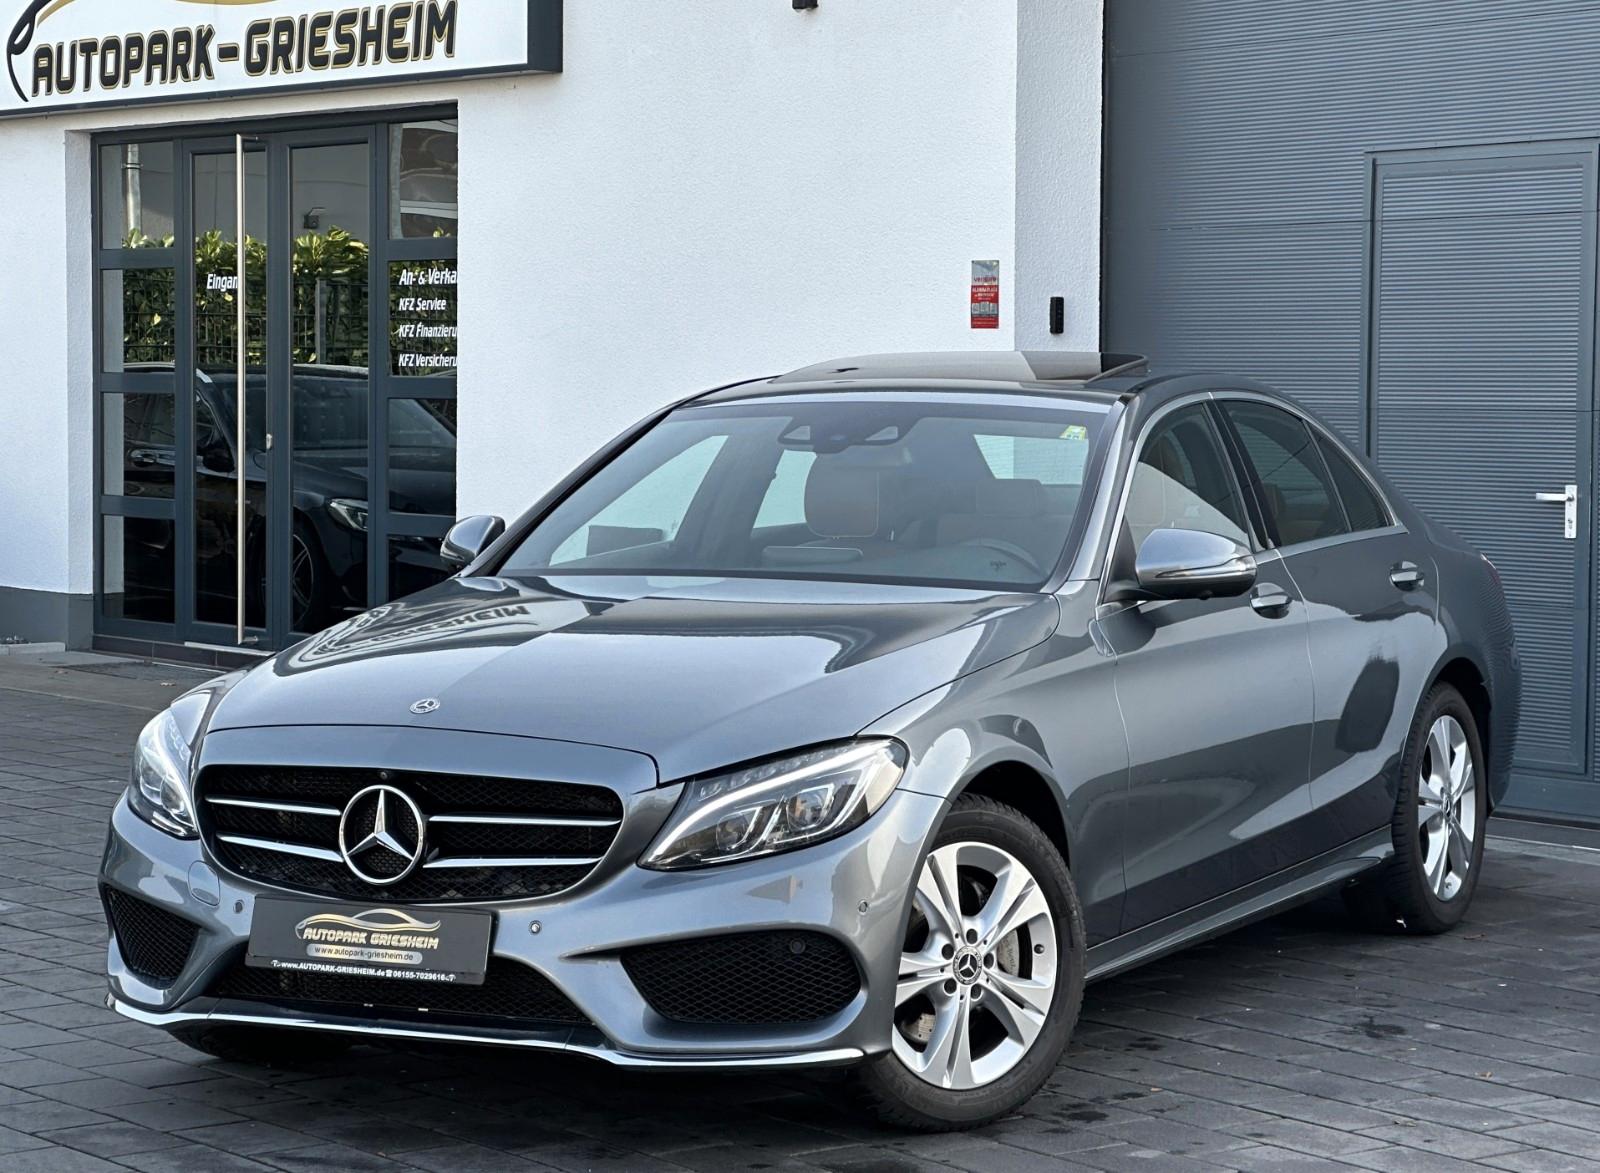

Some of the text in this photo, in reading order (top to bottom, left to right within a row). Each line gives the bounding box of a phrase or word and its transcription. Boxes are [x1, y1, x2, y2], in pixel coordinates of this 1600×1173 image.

[31, 0, 457, 97] AUTOPARK-GRIESHEIM
[399, 268, 417, 285] An-
[417, 270, 426, 285] &
[398, 297, 447, 311] KFZ Service
[398, 324, 416, 338] KFZ
[398, 353, 416, 367] KFZ
[302, 927, 440, 950] AUTOPARK GRIESHEIM
[314, 946, 414, 961] www.autopark-griesheim.de
